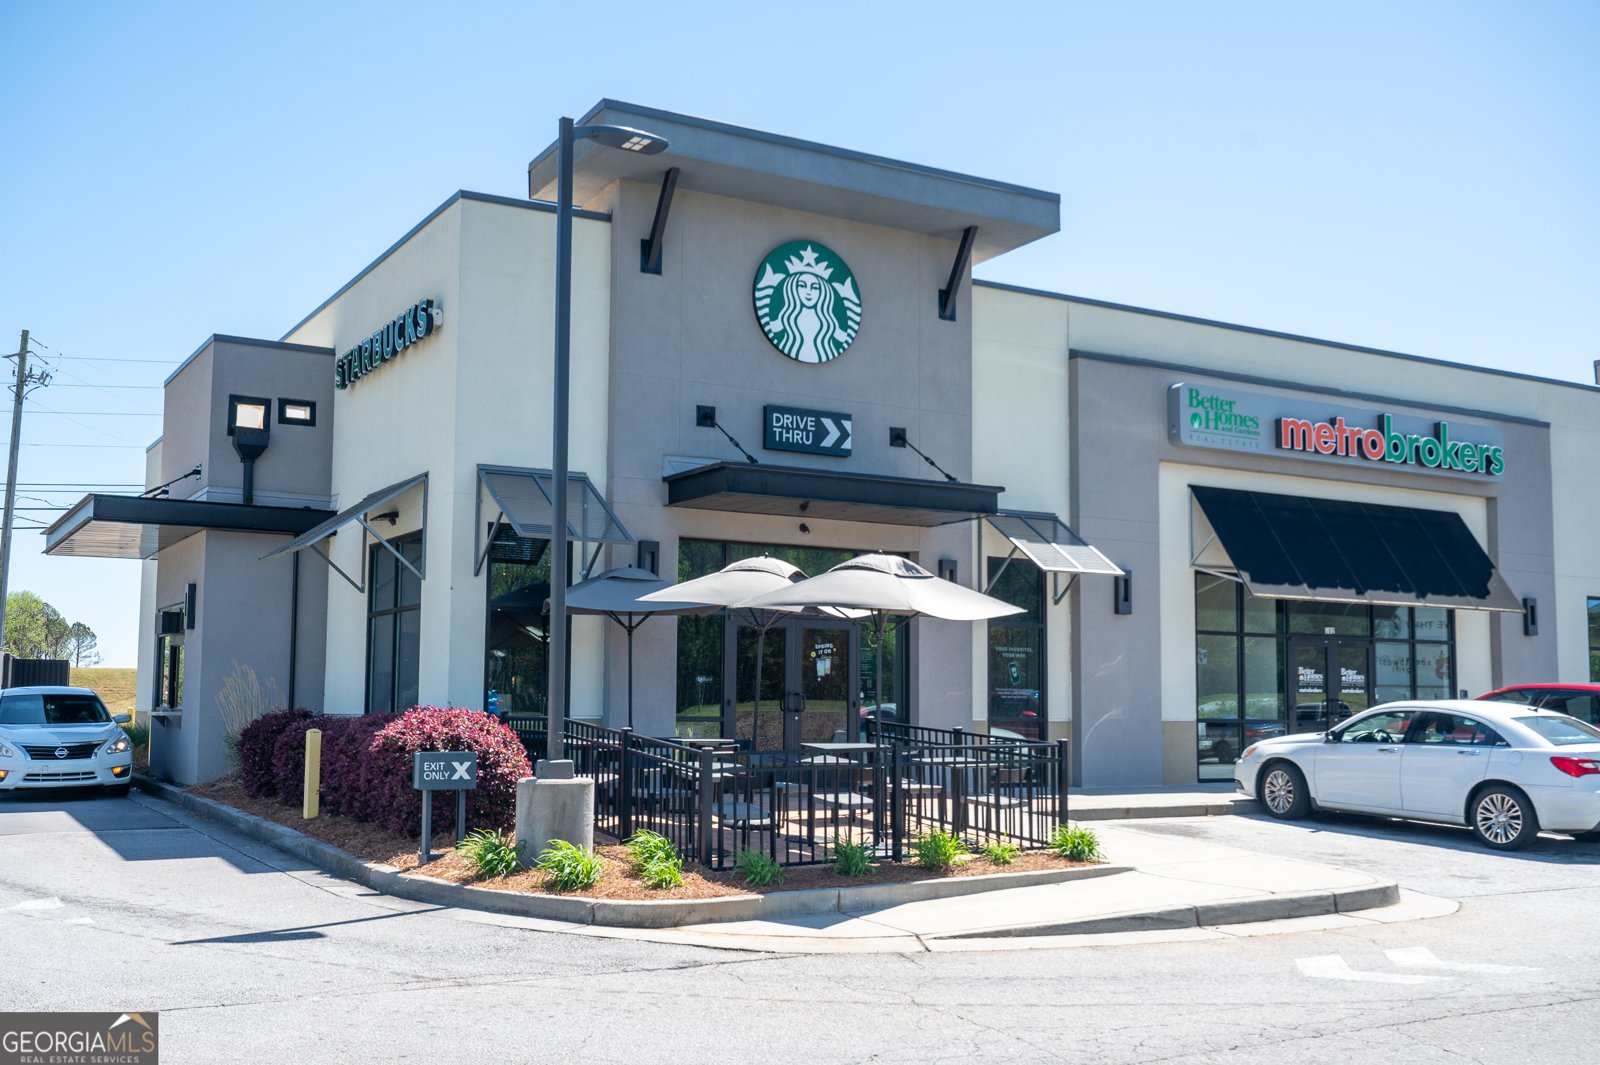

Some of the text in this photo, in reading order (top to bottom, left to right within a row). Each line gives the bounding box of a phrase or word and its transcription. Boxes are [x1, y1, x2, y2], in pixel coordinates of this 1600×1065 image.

[336, 298, 432, 390] STARBUCKS
[1187, 387, 1237, 413] Better
[772, 412, 816, 431] DRIVE
[1204, 410, 1260, 431] Homes
[772, 427, 813, 445] THRU
[1221, 438, 1260, 449] ESTATE
[423, 762, 445, 771] EXIT
[423, 771, 450, 780] ONLY
